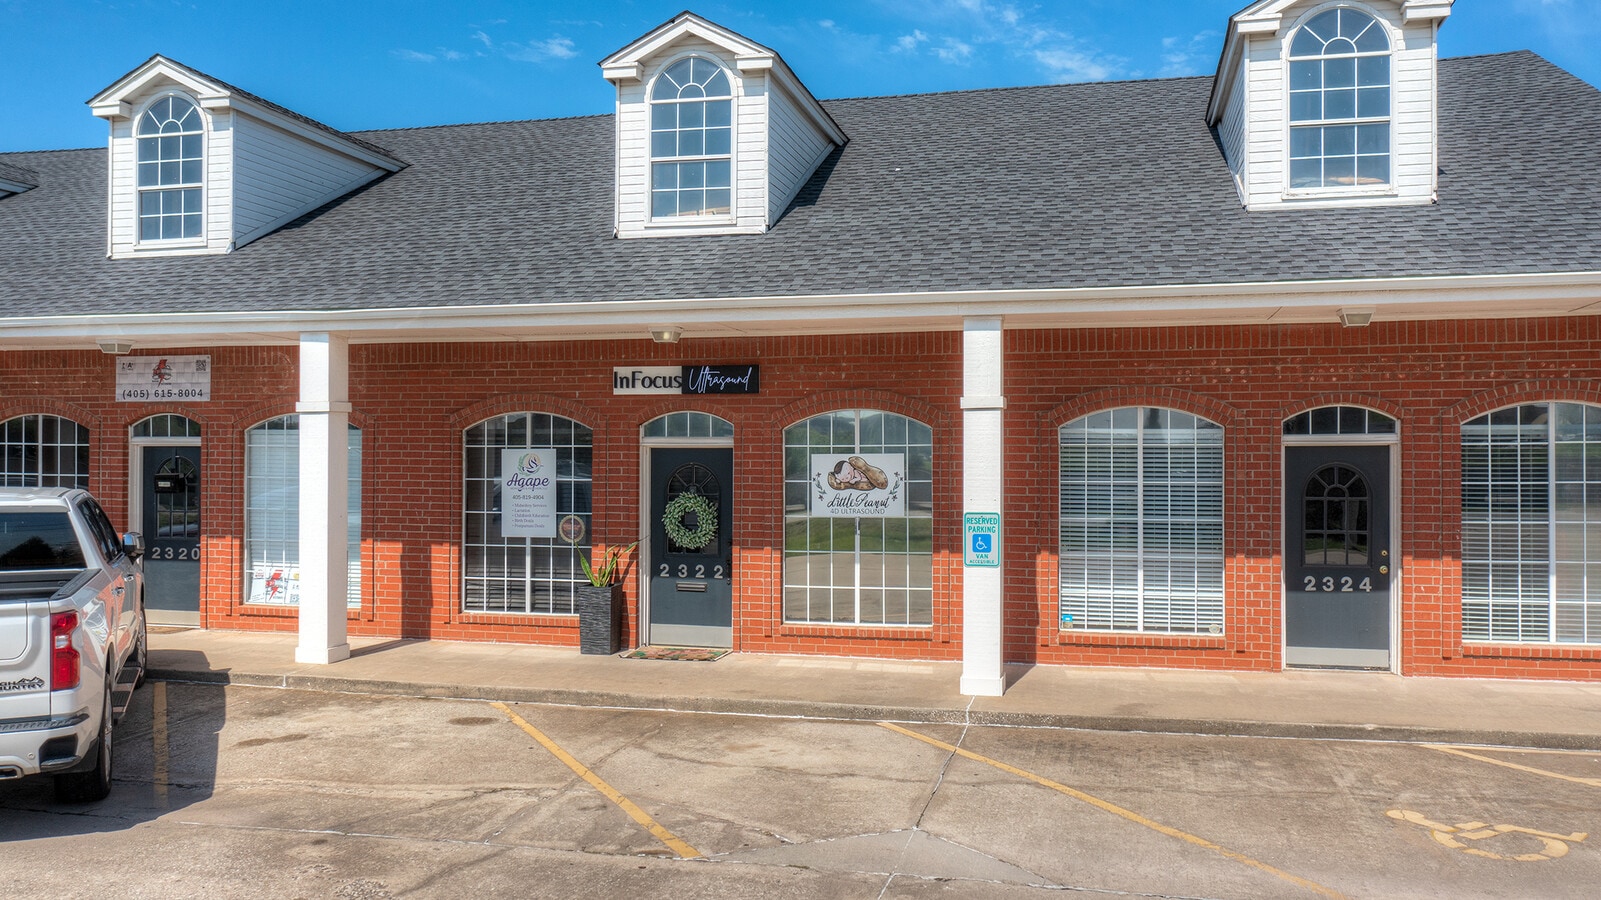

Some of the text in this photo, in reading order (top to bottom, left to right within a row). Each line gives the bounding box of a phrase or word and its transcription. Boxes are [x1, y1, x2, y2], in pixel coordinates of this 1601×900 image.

[613, 366, 753, 394] InFocus Ultrasound
[122, 388, 203, 400] (405) 615-8004
[507, 473, 549, 491] Agape
[827, 492, 890, 508] Little Peanut
[966, 517, 998, 525] RESERVED
[151, 547, 200, 560] 2320
[659, 563, 724, 579] 2322
[1303, 575, 1373, 593] 2324
